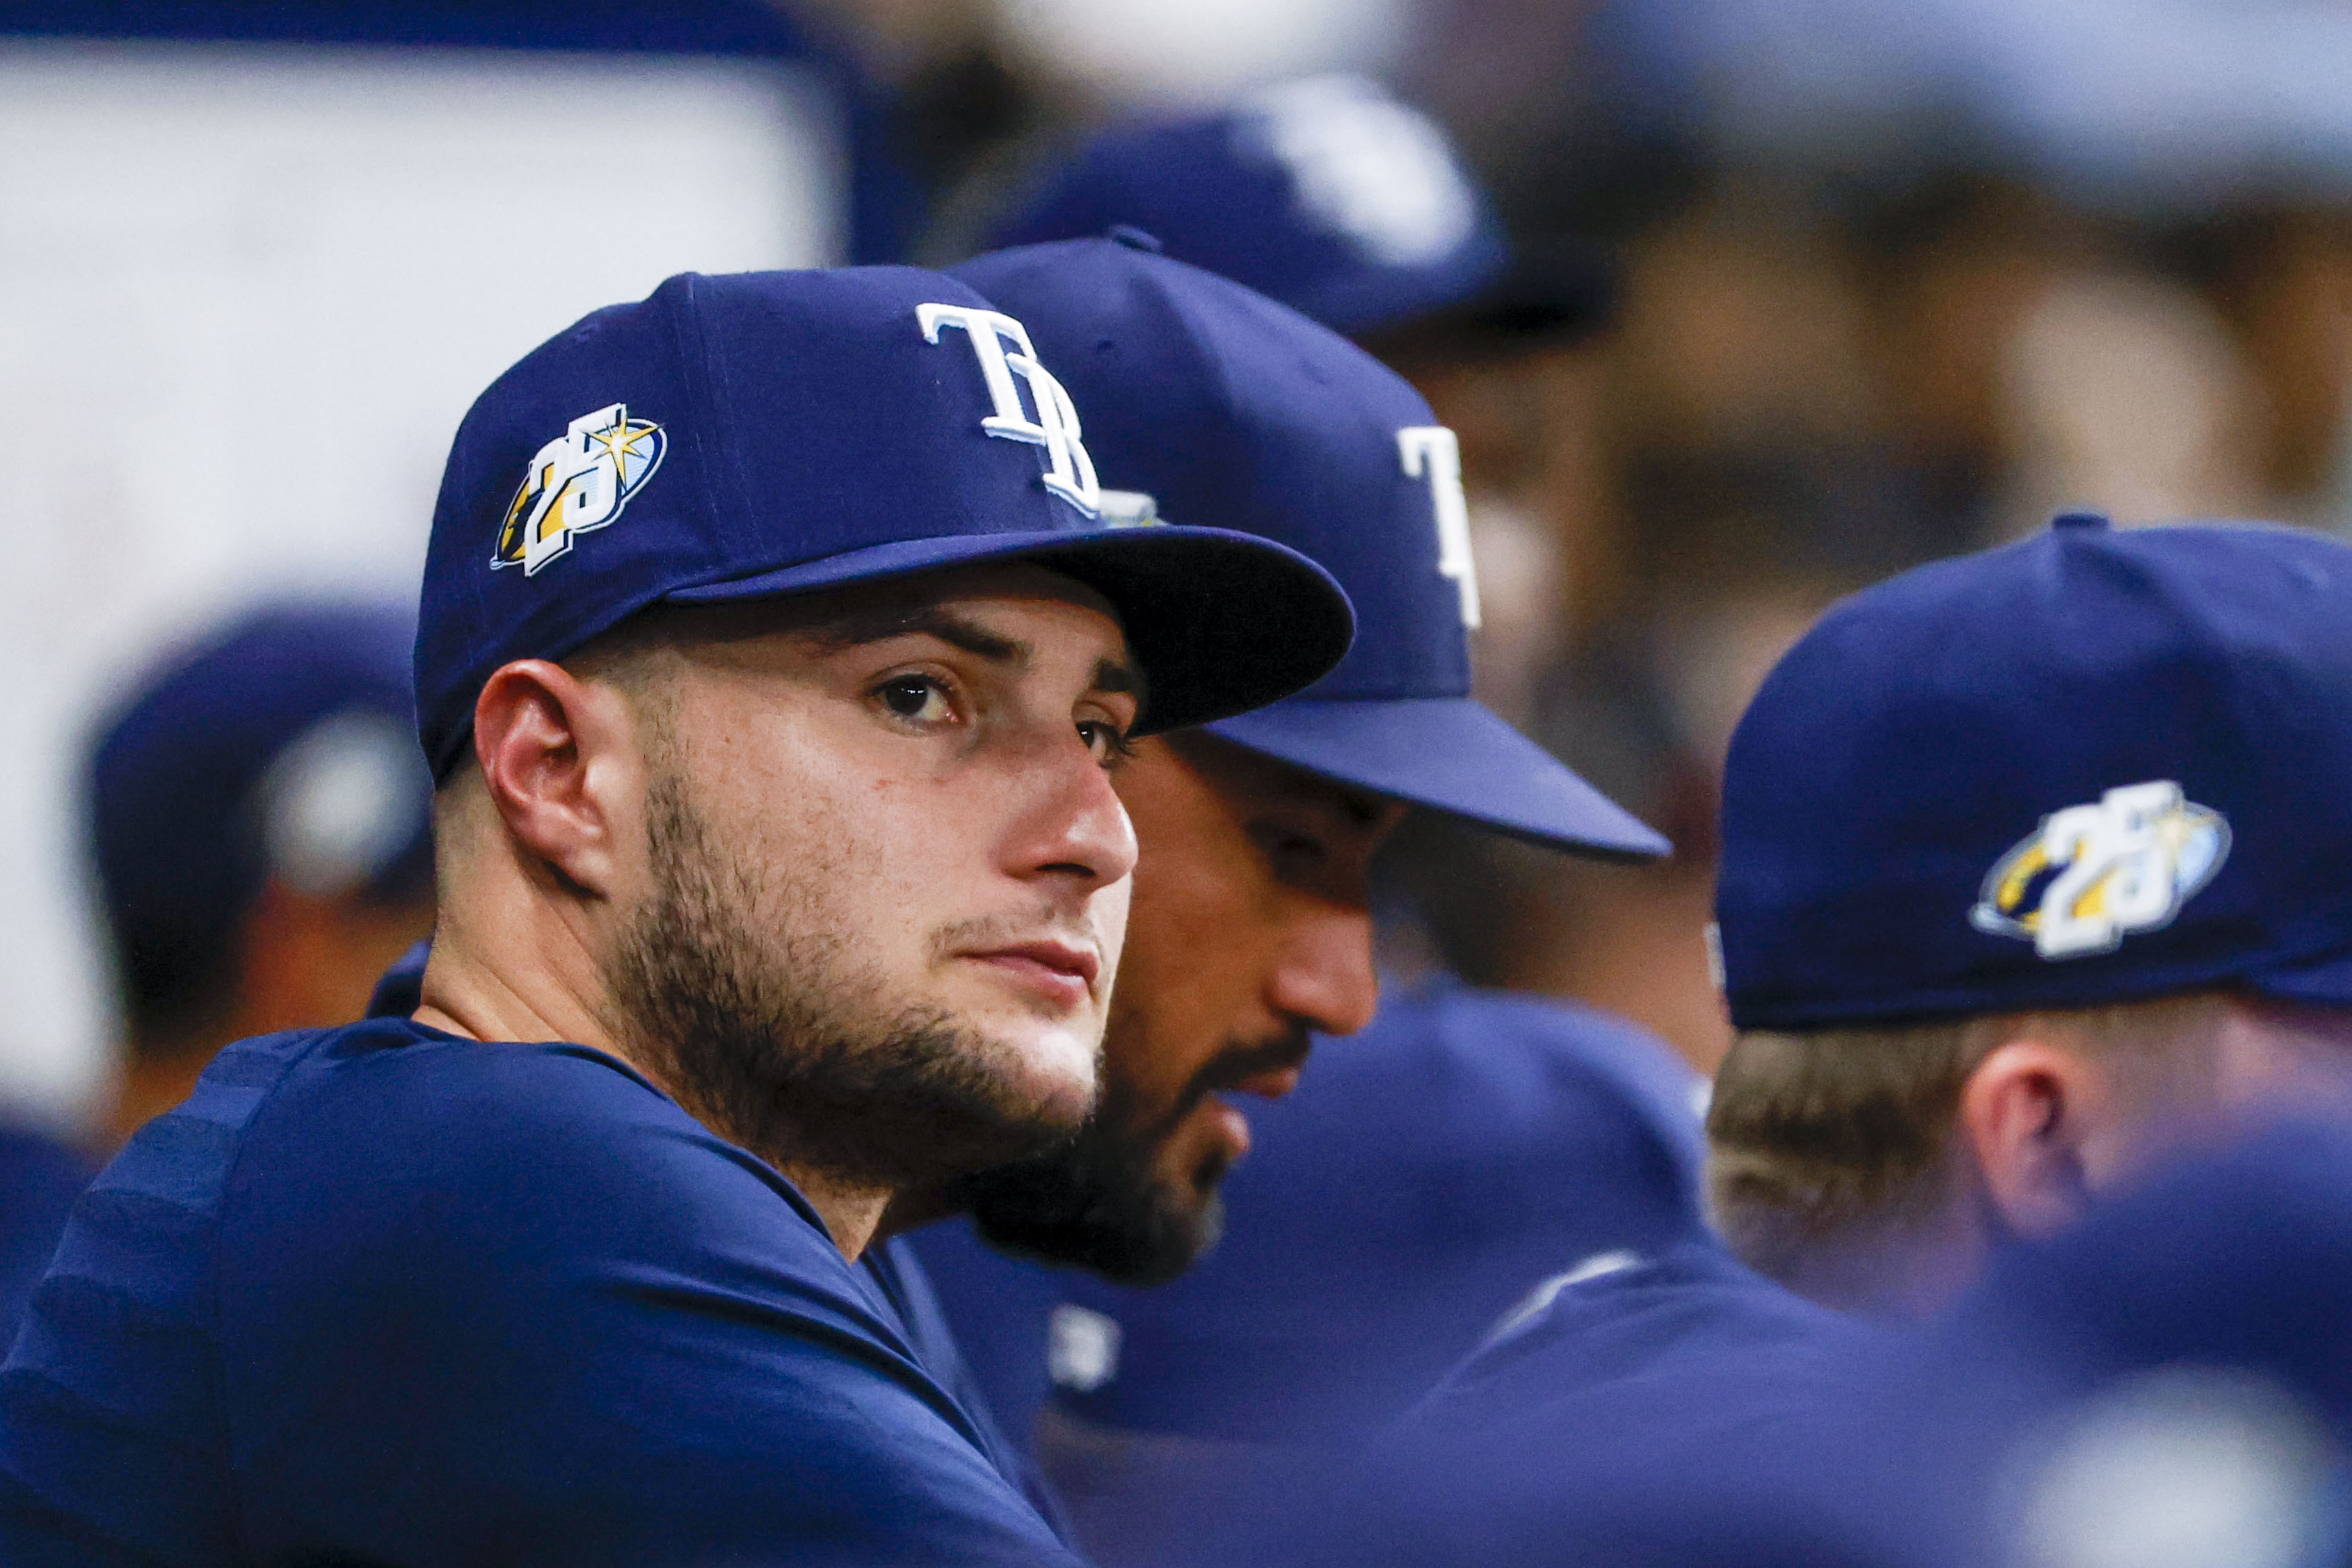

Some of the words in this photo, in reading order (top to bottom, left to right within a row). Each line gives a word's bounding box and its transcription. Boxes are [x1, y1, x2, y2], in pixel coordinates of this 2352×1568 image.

[524, 402, 627, 577] 25
[915, 302, 1101, 520] TB
[1396, 425, 1481, 629] T
[2036, 779, 2184, 961] 25
